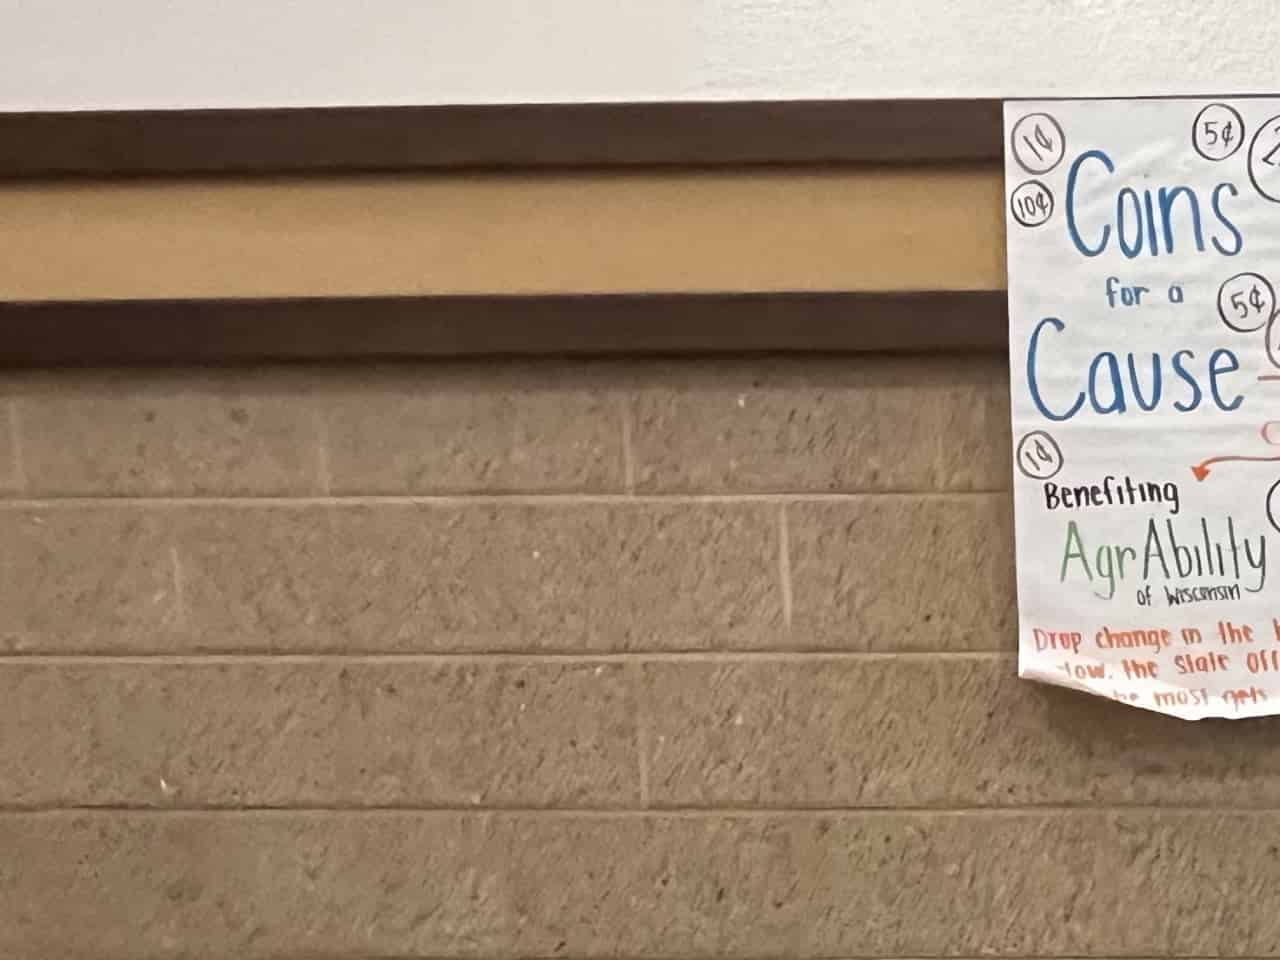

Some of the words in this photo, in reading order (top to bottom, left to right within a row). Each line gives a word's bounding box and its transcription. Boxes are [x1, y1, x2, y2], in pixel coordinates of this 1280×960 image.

[1204, 121, 1235, 147] 5¢
[1018, 192, 1049, 219] 10¢
[1065, 150, 1243, 258] Coins
[1106, 277, 1150, 308] for
[1168, 285, 1184, 304] a
[1230, 284, 1266, 319] 5¢
[1027, 317, 1245, 421] Cause
[1043, 475, 1180, 515] Benefiting
[1060, 516, 1266, 601] AgrAbility
[1136, 585, 1152, 606] of
[1033, 628, 1082, 655] Drop
[1095, 626, 1171, 655] change
[1217, 620, 1255, 646] the
